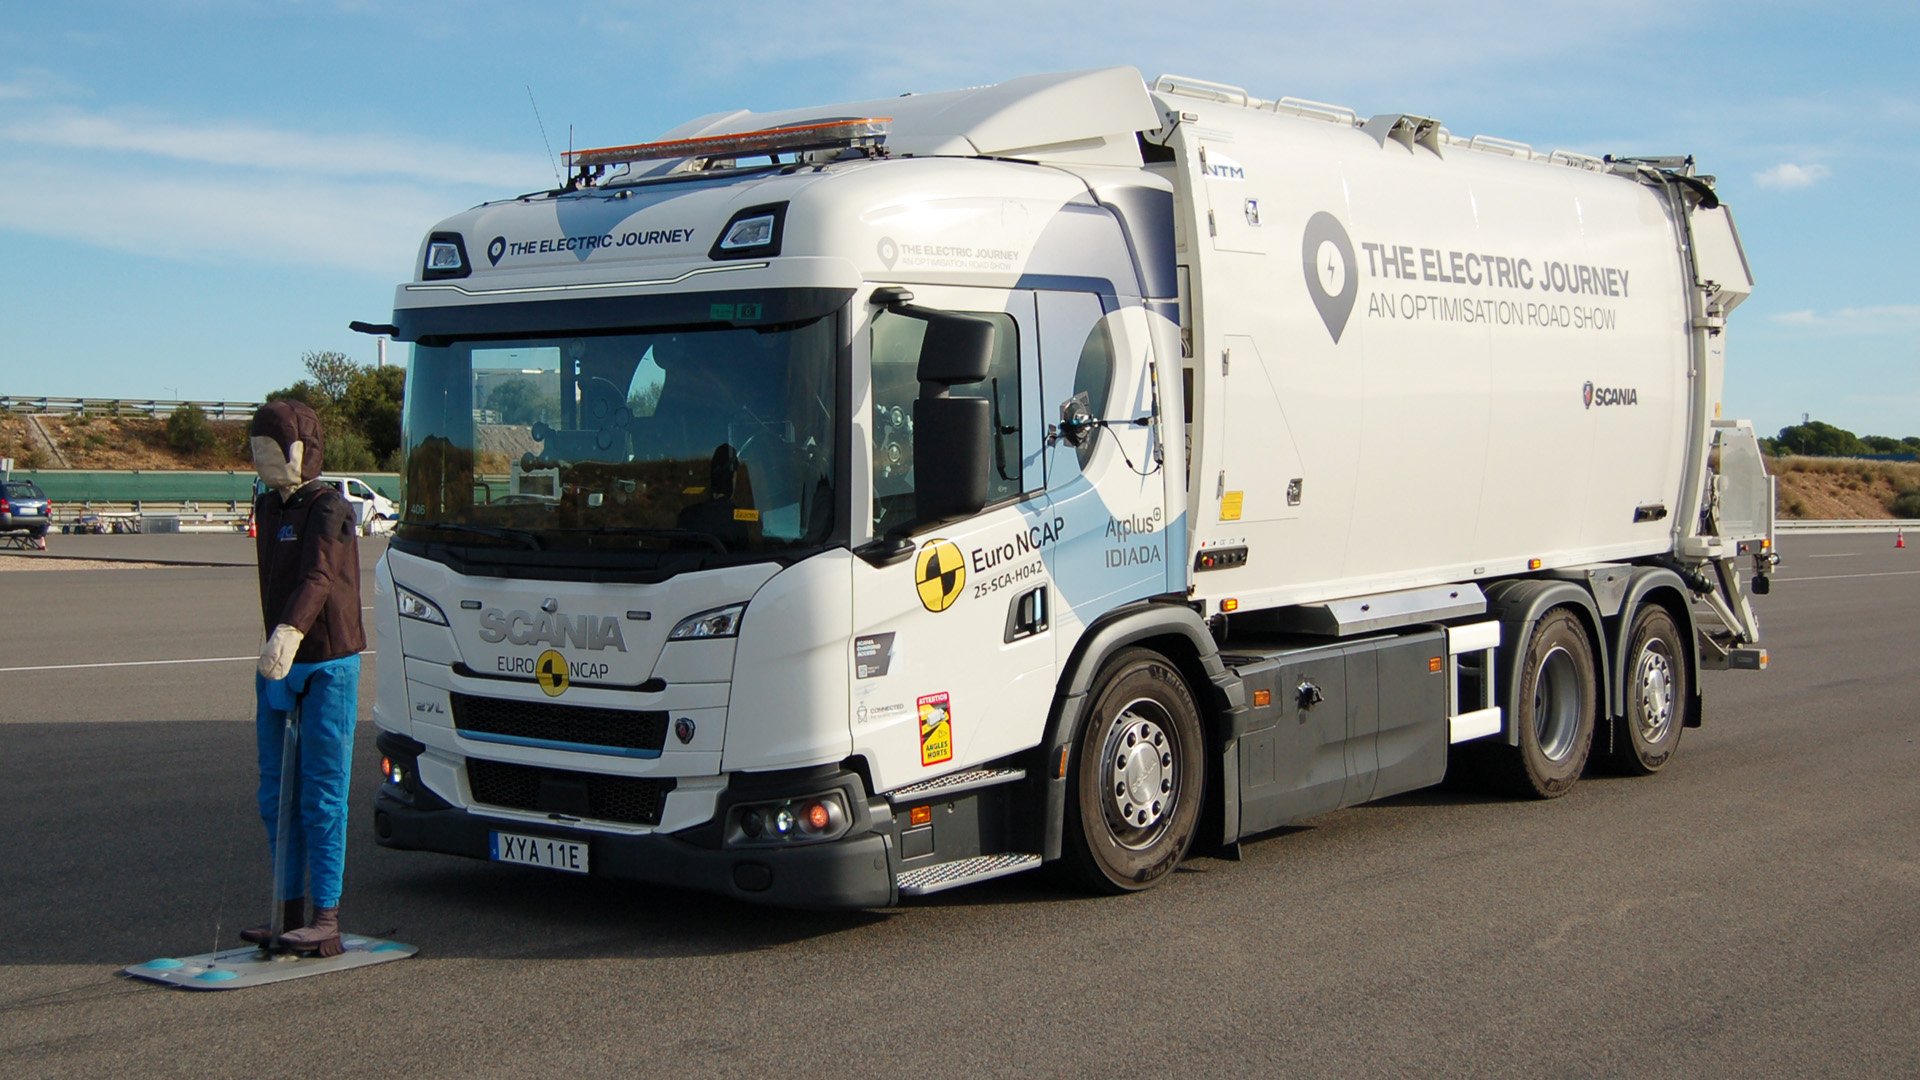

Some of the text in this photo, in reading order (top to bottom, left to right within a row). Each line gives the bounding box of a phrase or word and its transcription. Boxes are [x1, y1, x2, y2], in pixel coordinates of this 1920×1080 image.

[509, 228, 695, 256] THE ELECTRIC JOURNEY
[900, 244, 1019, 260] THE ELECTRIC JOURNEY
[1361, 242, 1629, 298] THE ELECTRIC JOURNEY
[1368, 292, 1616, 330] AN OPTIMISATION ROAD SHOW
[1595, 388, 1638, 406] SCANIA
[971, 516, 1065, 573] Euro NCAP
[1105, 544, 1161, 568] IDIADA
[974, 560, 1043, 599] 25-SCA-H042
[478, 608, 629, 652] SCANIA
[498, 656, 609, 679] EURO NCAP
[416, 702, 444, 714] 27L
[926, 740, 948, 751] ANGLES
[927, 748, 948, 759] MORTS
[504, 835, 580, 869] XYA 11E
